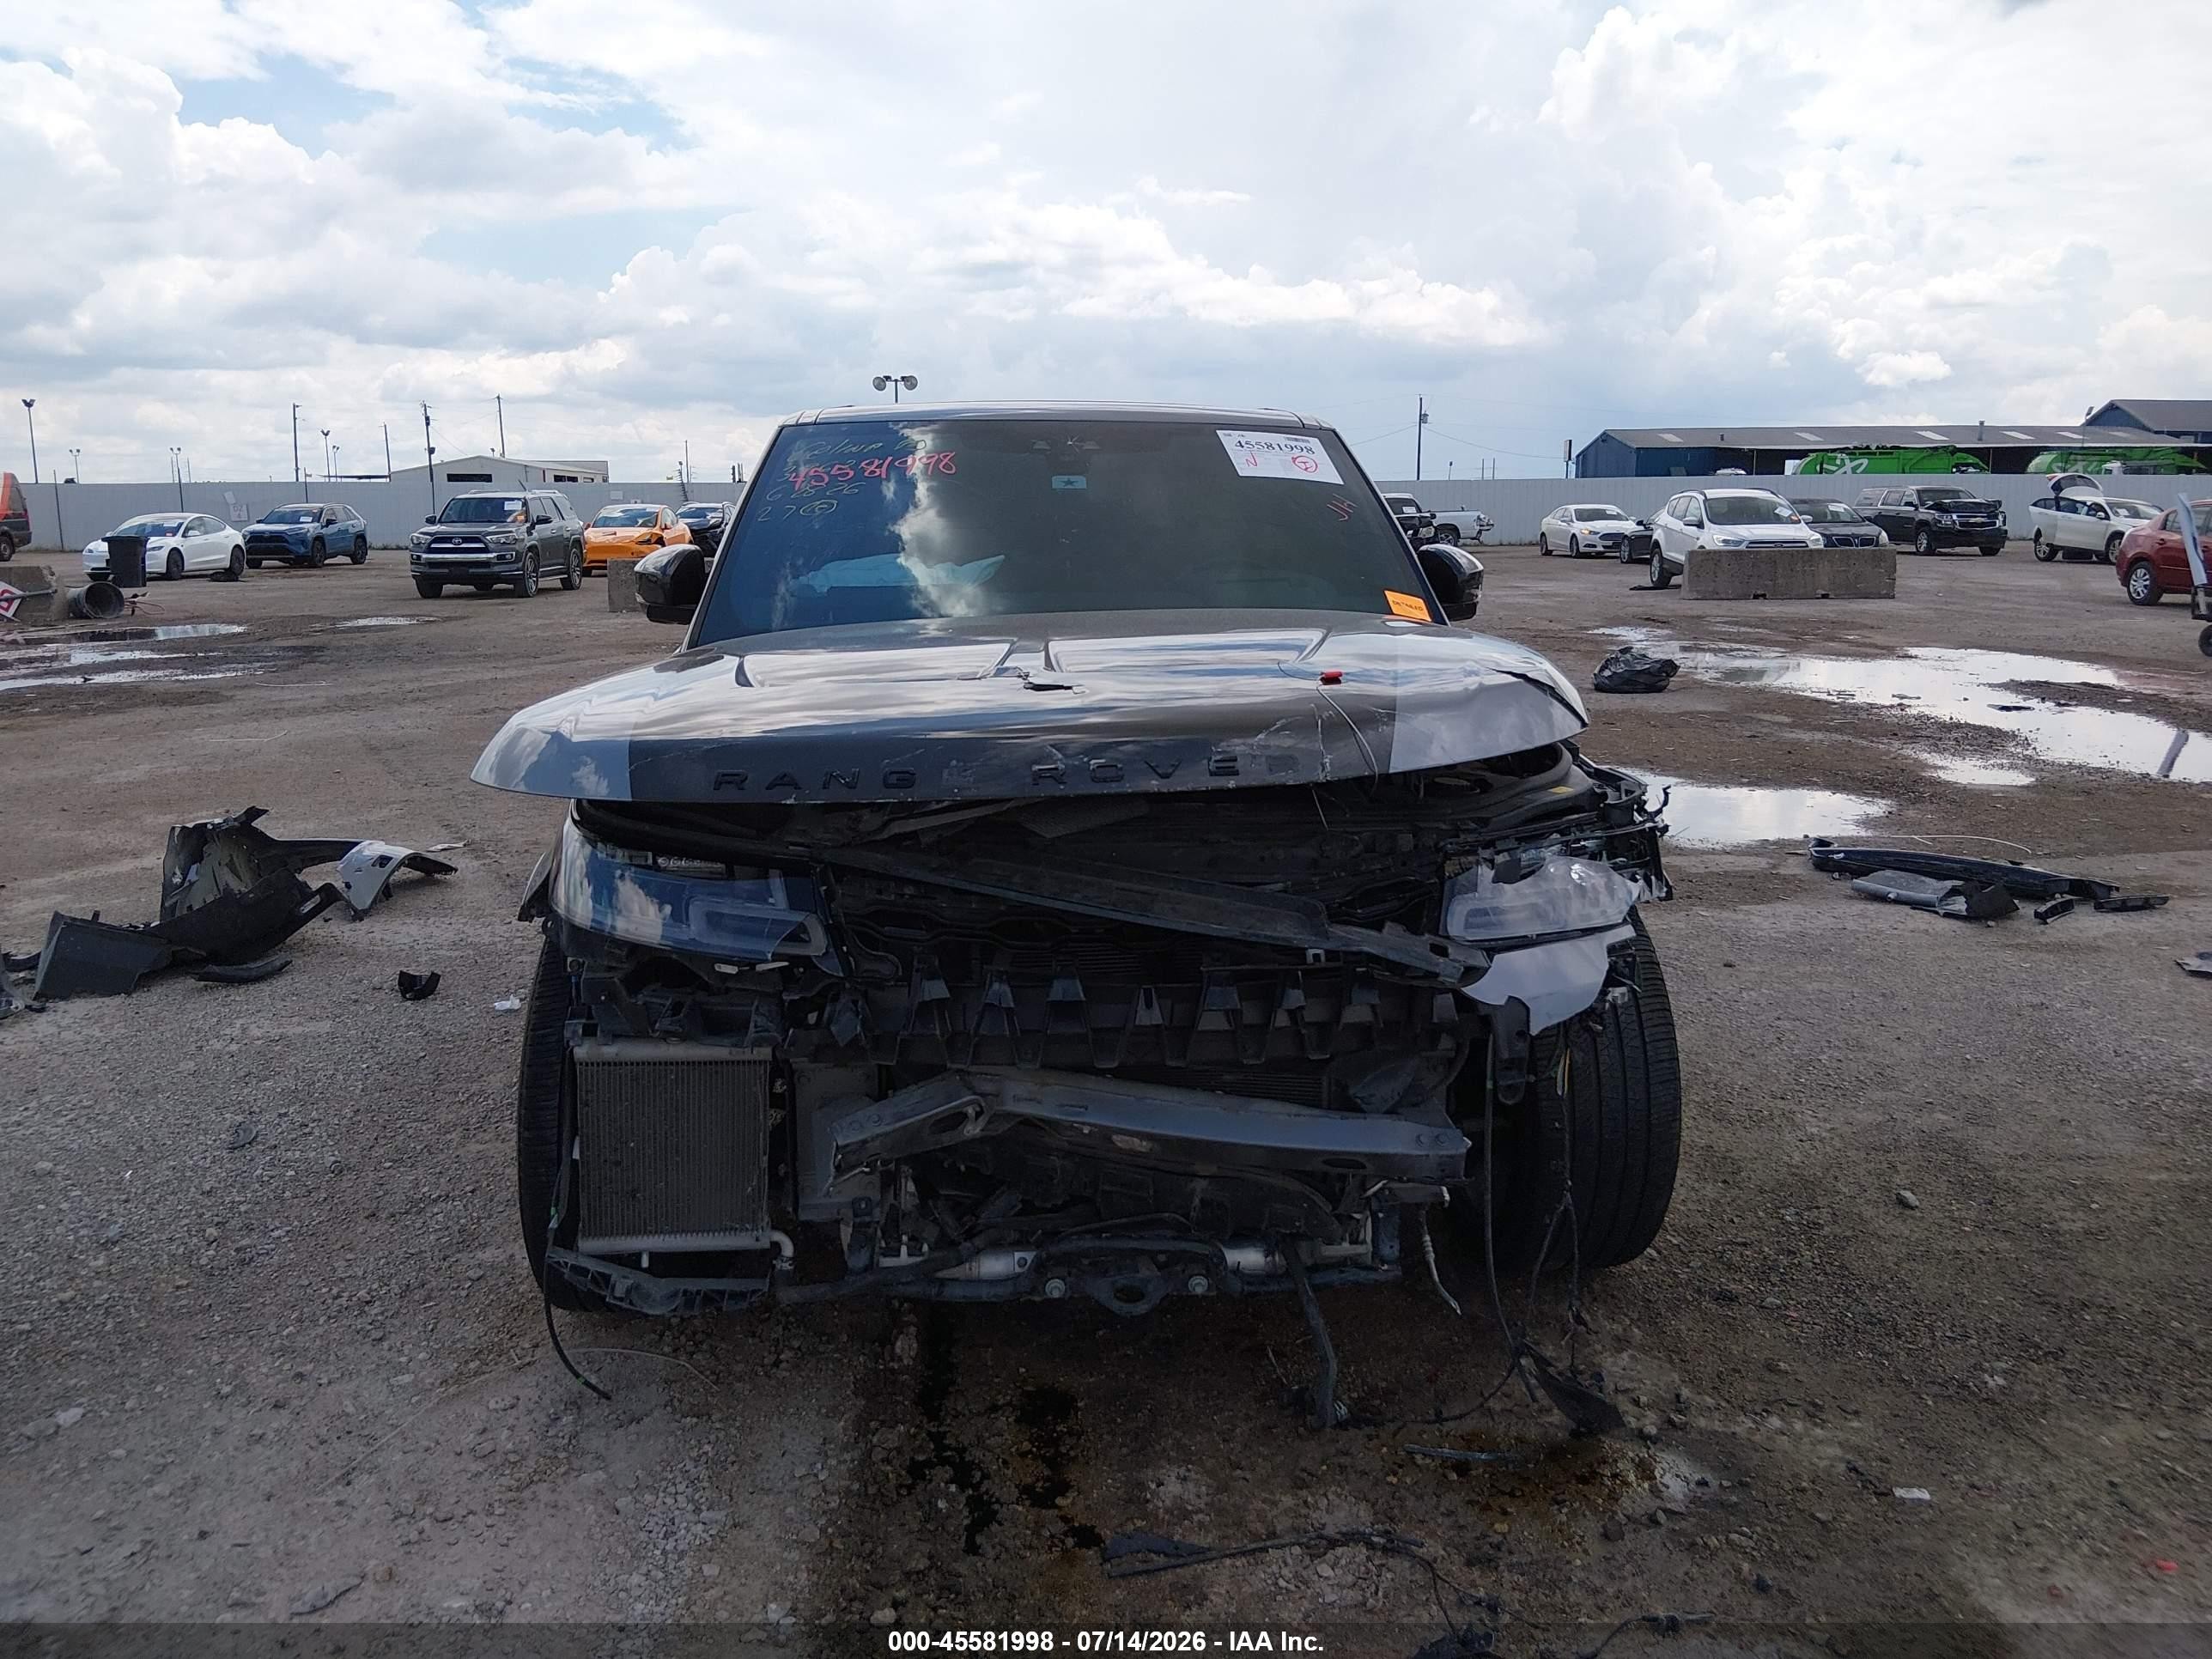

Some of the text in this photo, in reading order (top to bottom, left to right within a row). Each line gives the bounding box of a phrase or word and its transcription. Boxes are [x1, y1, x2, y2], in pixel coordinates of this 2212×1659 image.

[1234, 439, 1316, 455] 45581998
[788, 451, 957, 491] 45581998
[713, 767, 974, 791] RANG
